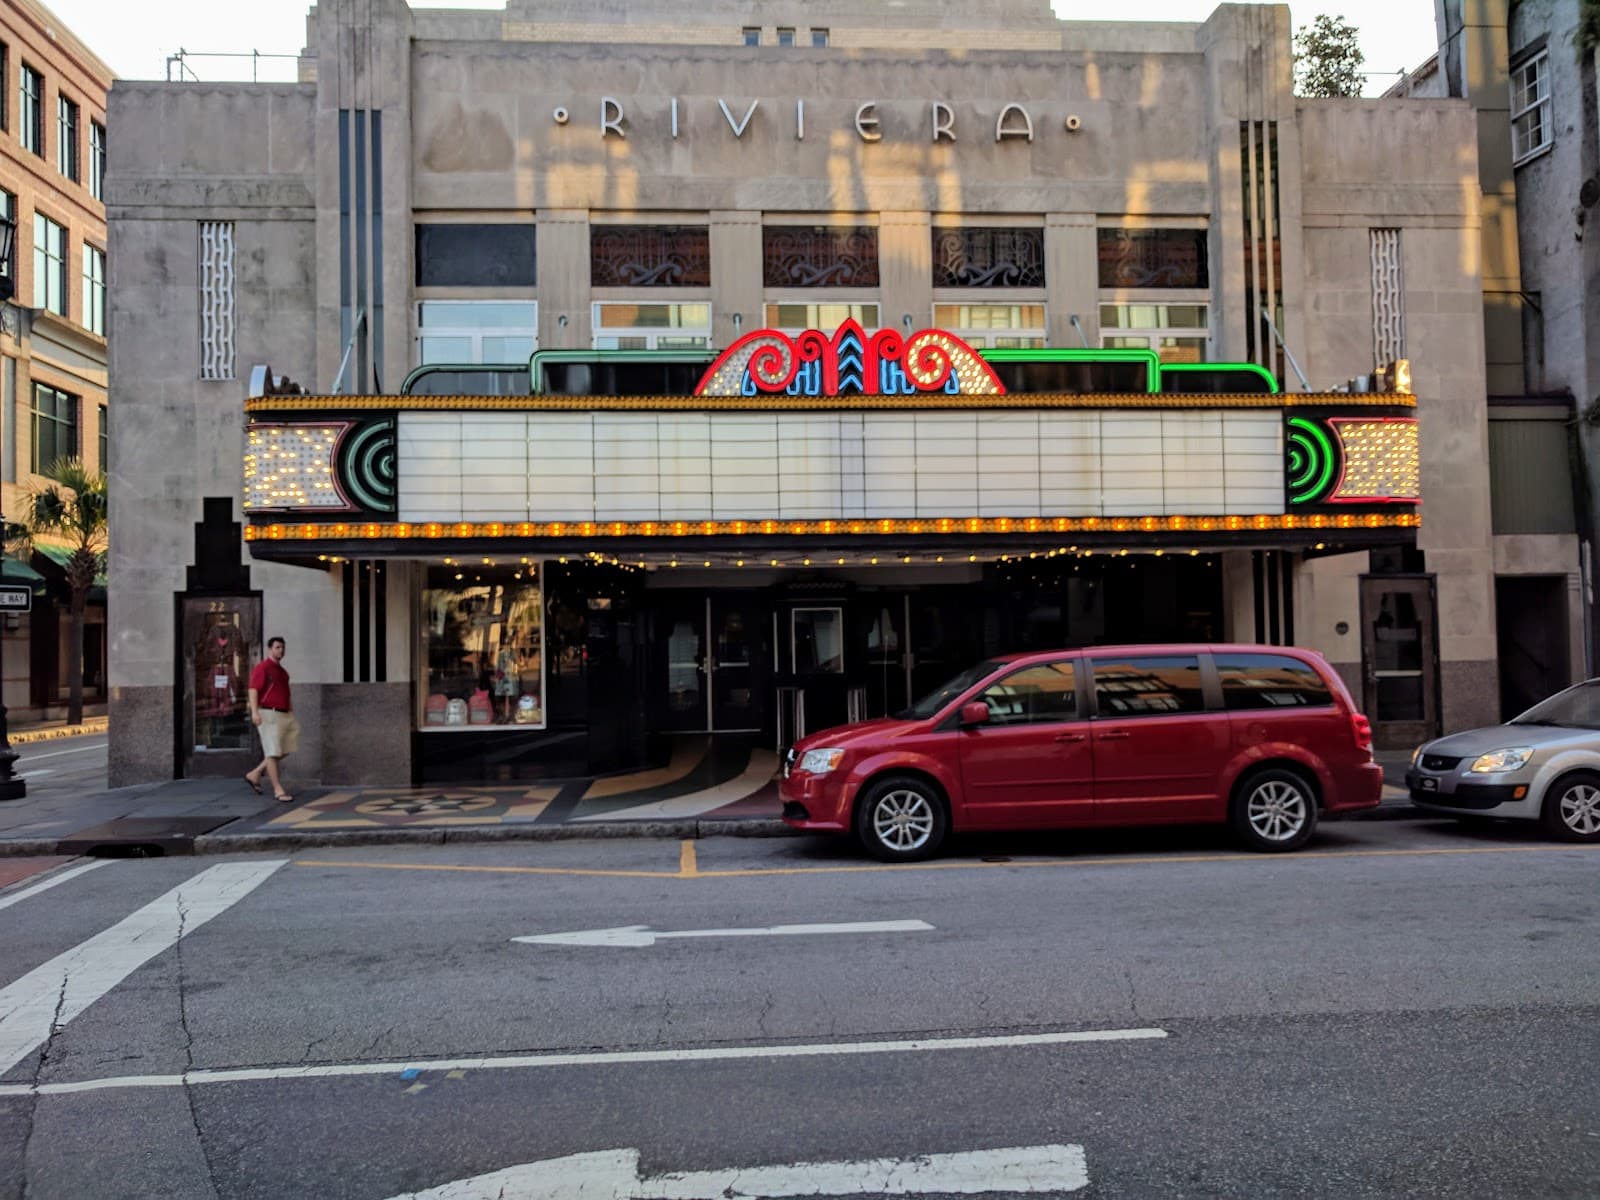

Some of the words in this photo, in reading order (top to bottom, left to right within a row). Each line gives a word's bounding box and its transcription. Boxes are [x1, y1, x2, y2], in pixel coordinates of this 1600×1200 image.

[600, 96, 1034, 141] RIVIERA
[8, 593, 25, 604] WAY
[209, 601, 225, 611] 22
